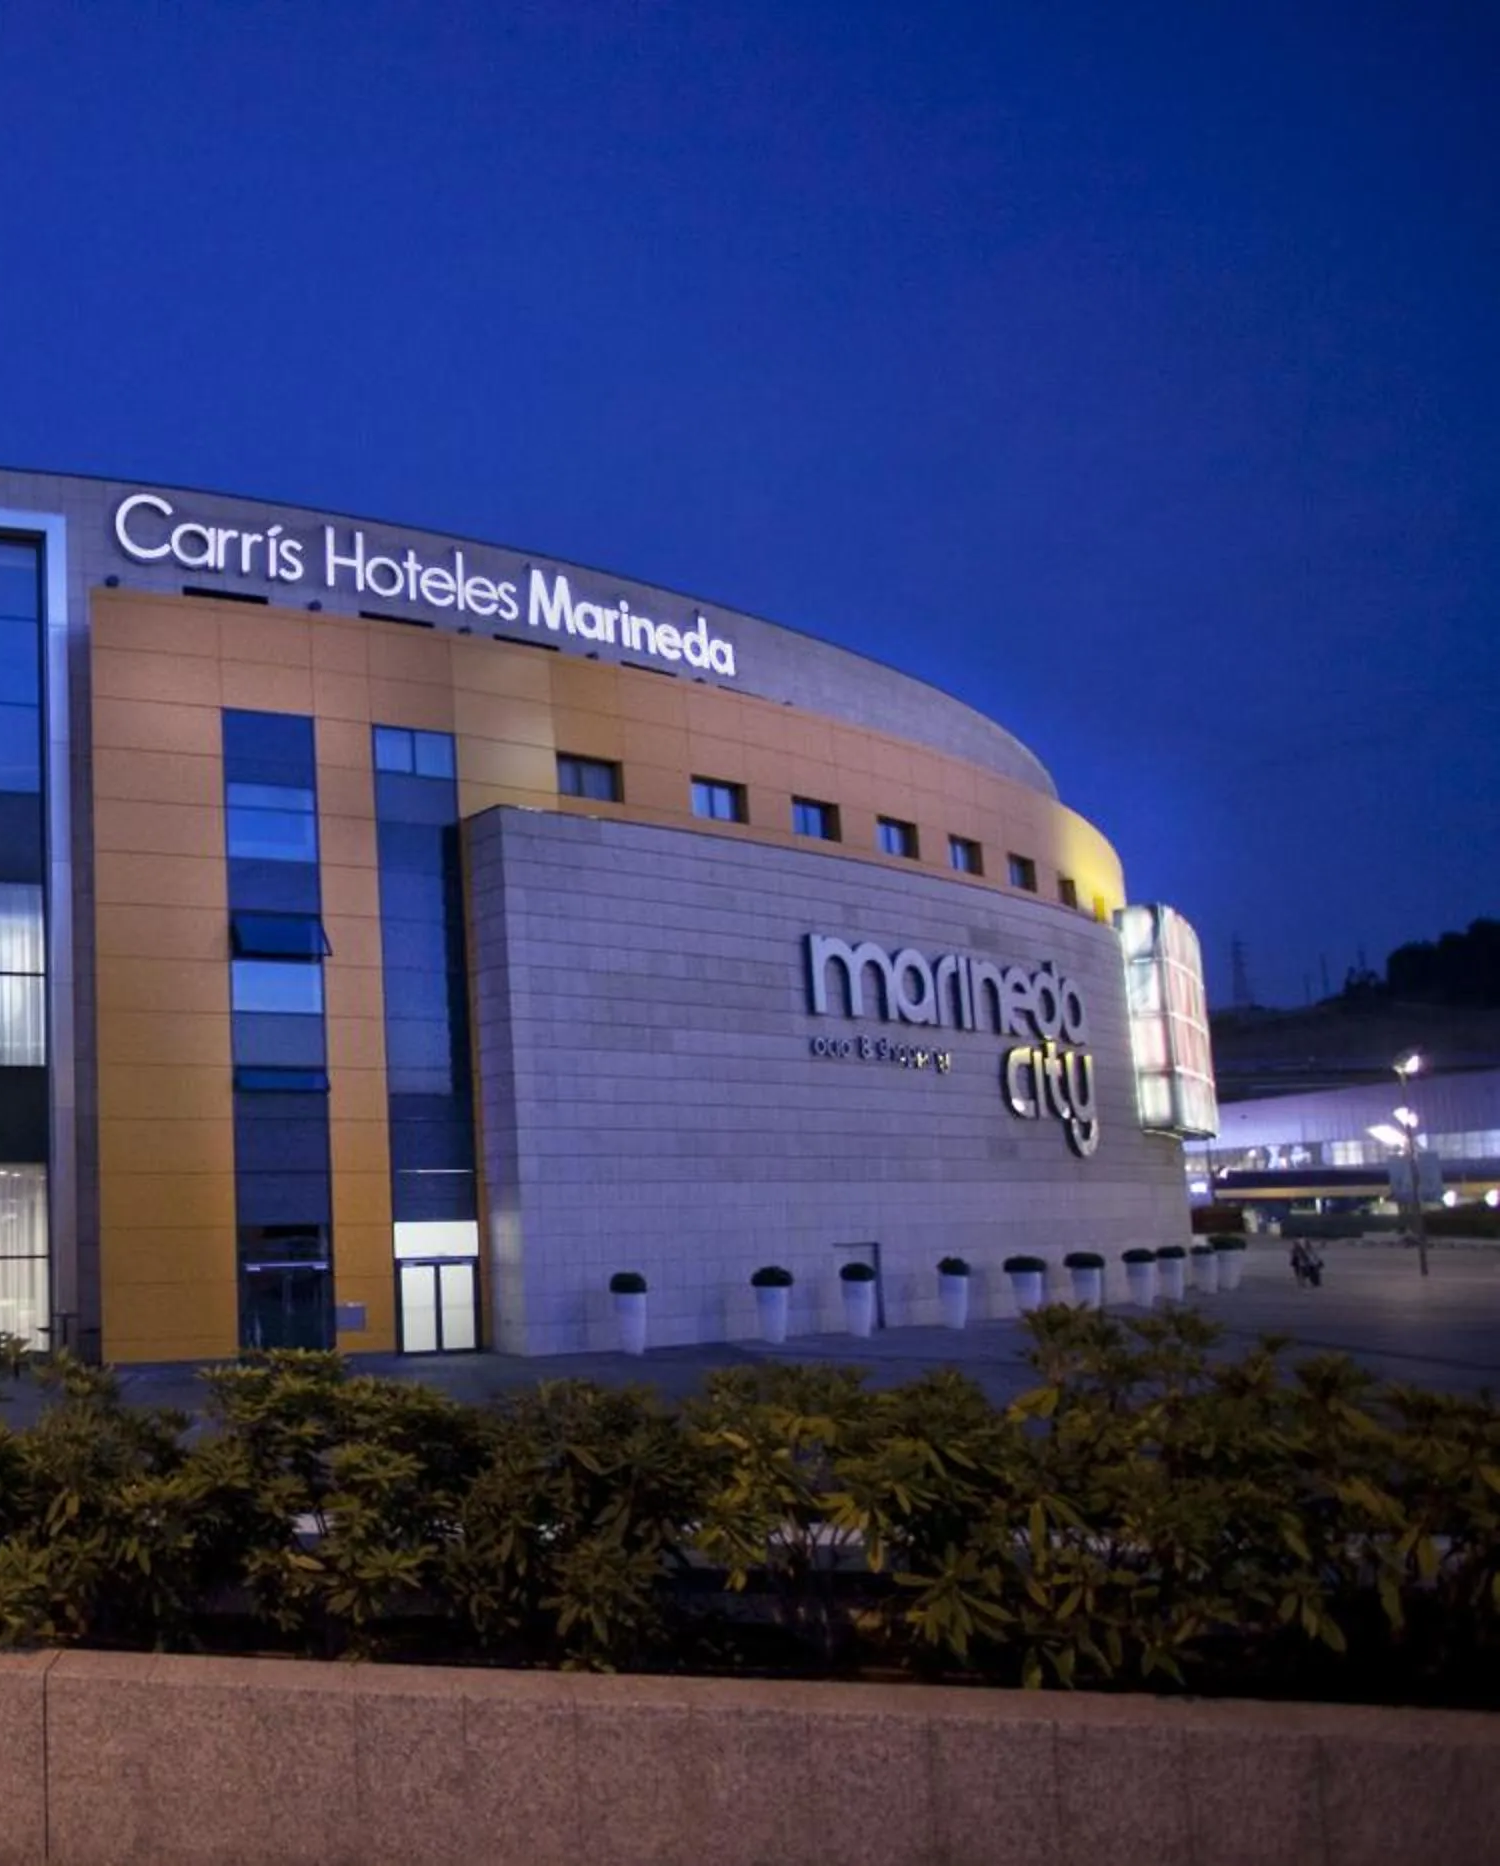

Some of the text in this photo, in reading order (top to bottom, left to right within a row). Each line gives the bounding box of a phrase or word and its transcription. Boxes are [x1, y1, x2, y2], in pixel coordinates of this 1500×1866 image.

[114, 493, 736, 678] Carrís Hoteles Marineda
[805, 933, 1090, 1046] marineda
[1005, 1040, 1098, 1158] city
